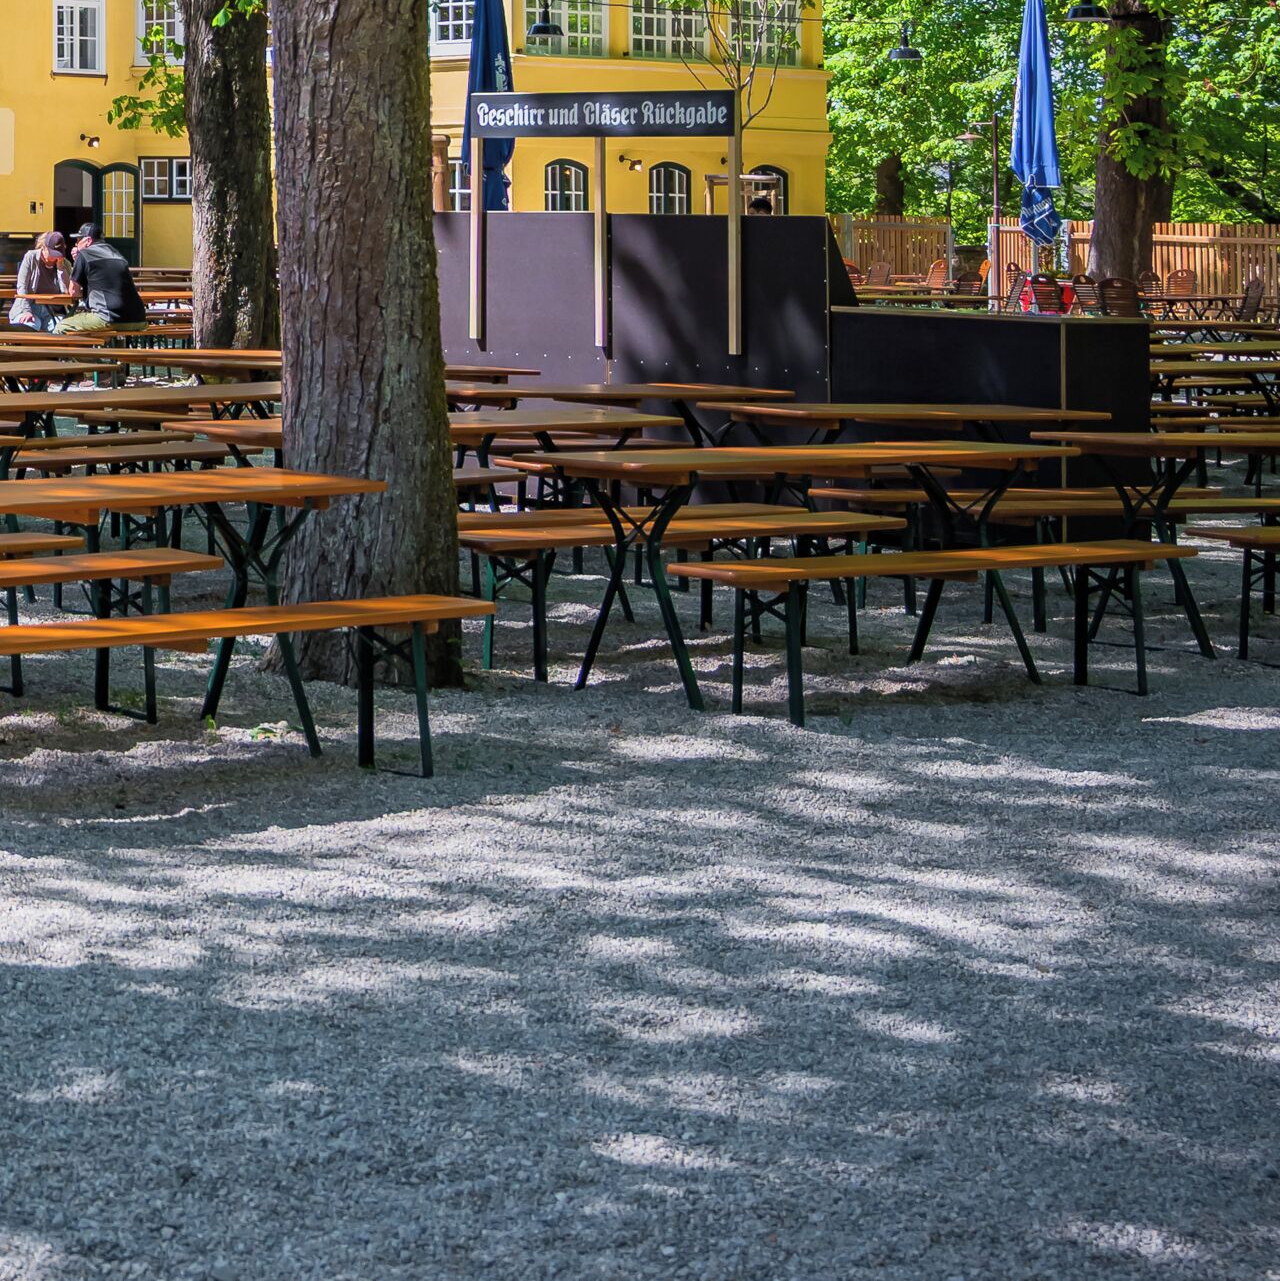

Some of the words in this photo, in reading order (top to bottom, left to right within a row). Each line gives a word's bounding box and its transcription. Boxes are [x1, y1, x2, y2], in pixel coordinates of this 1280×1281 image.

[477, 102, 546, 127] Geschirr
[548, 103, 579, 127] und
[583, 101, 638, 127] Gläser
[642, 101, 728, 129] Rückgabe
